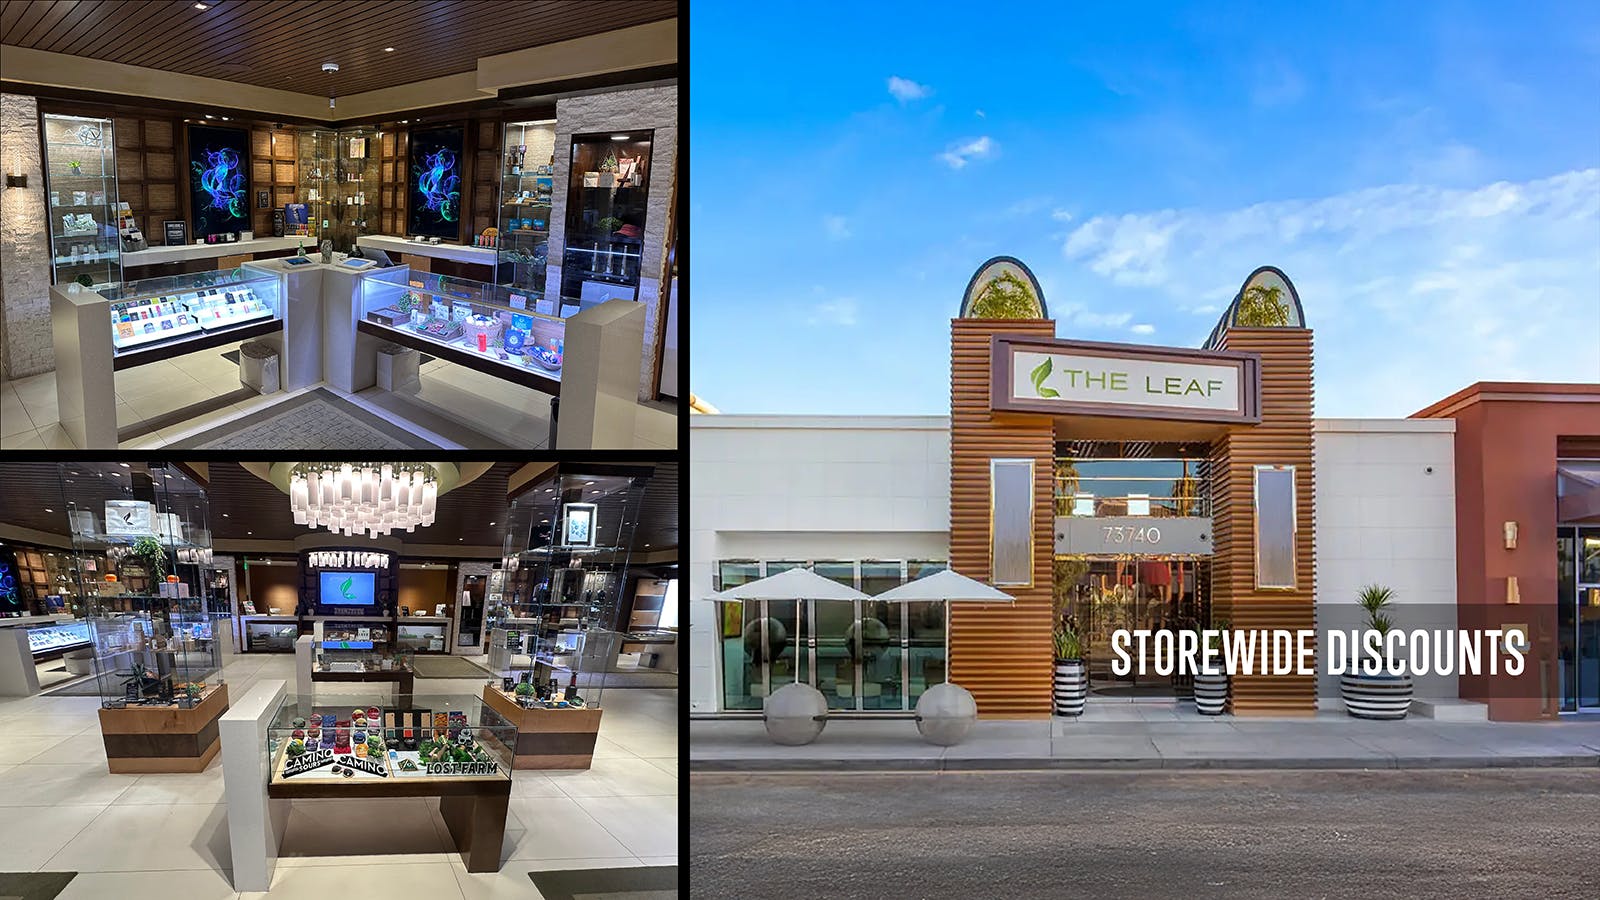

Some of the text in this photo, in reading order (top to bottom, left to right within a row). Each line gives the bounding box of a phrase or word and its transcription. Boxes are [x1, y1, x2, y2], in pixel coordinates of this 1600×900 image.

[1064, 369, 1223, 397] THE LEAF
[1104, 527, 1160, 544] 73740
[285, 749, 332, 770] CAMINO
[298, 761, 321, 772] SOURS
[339, 755, 385, 775] CAMINO
[426, 762, 498, 775] LOST FARM
